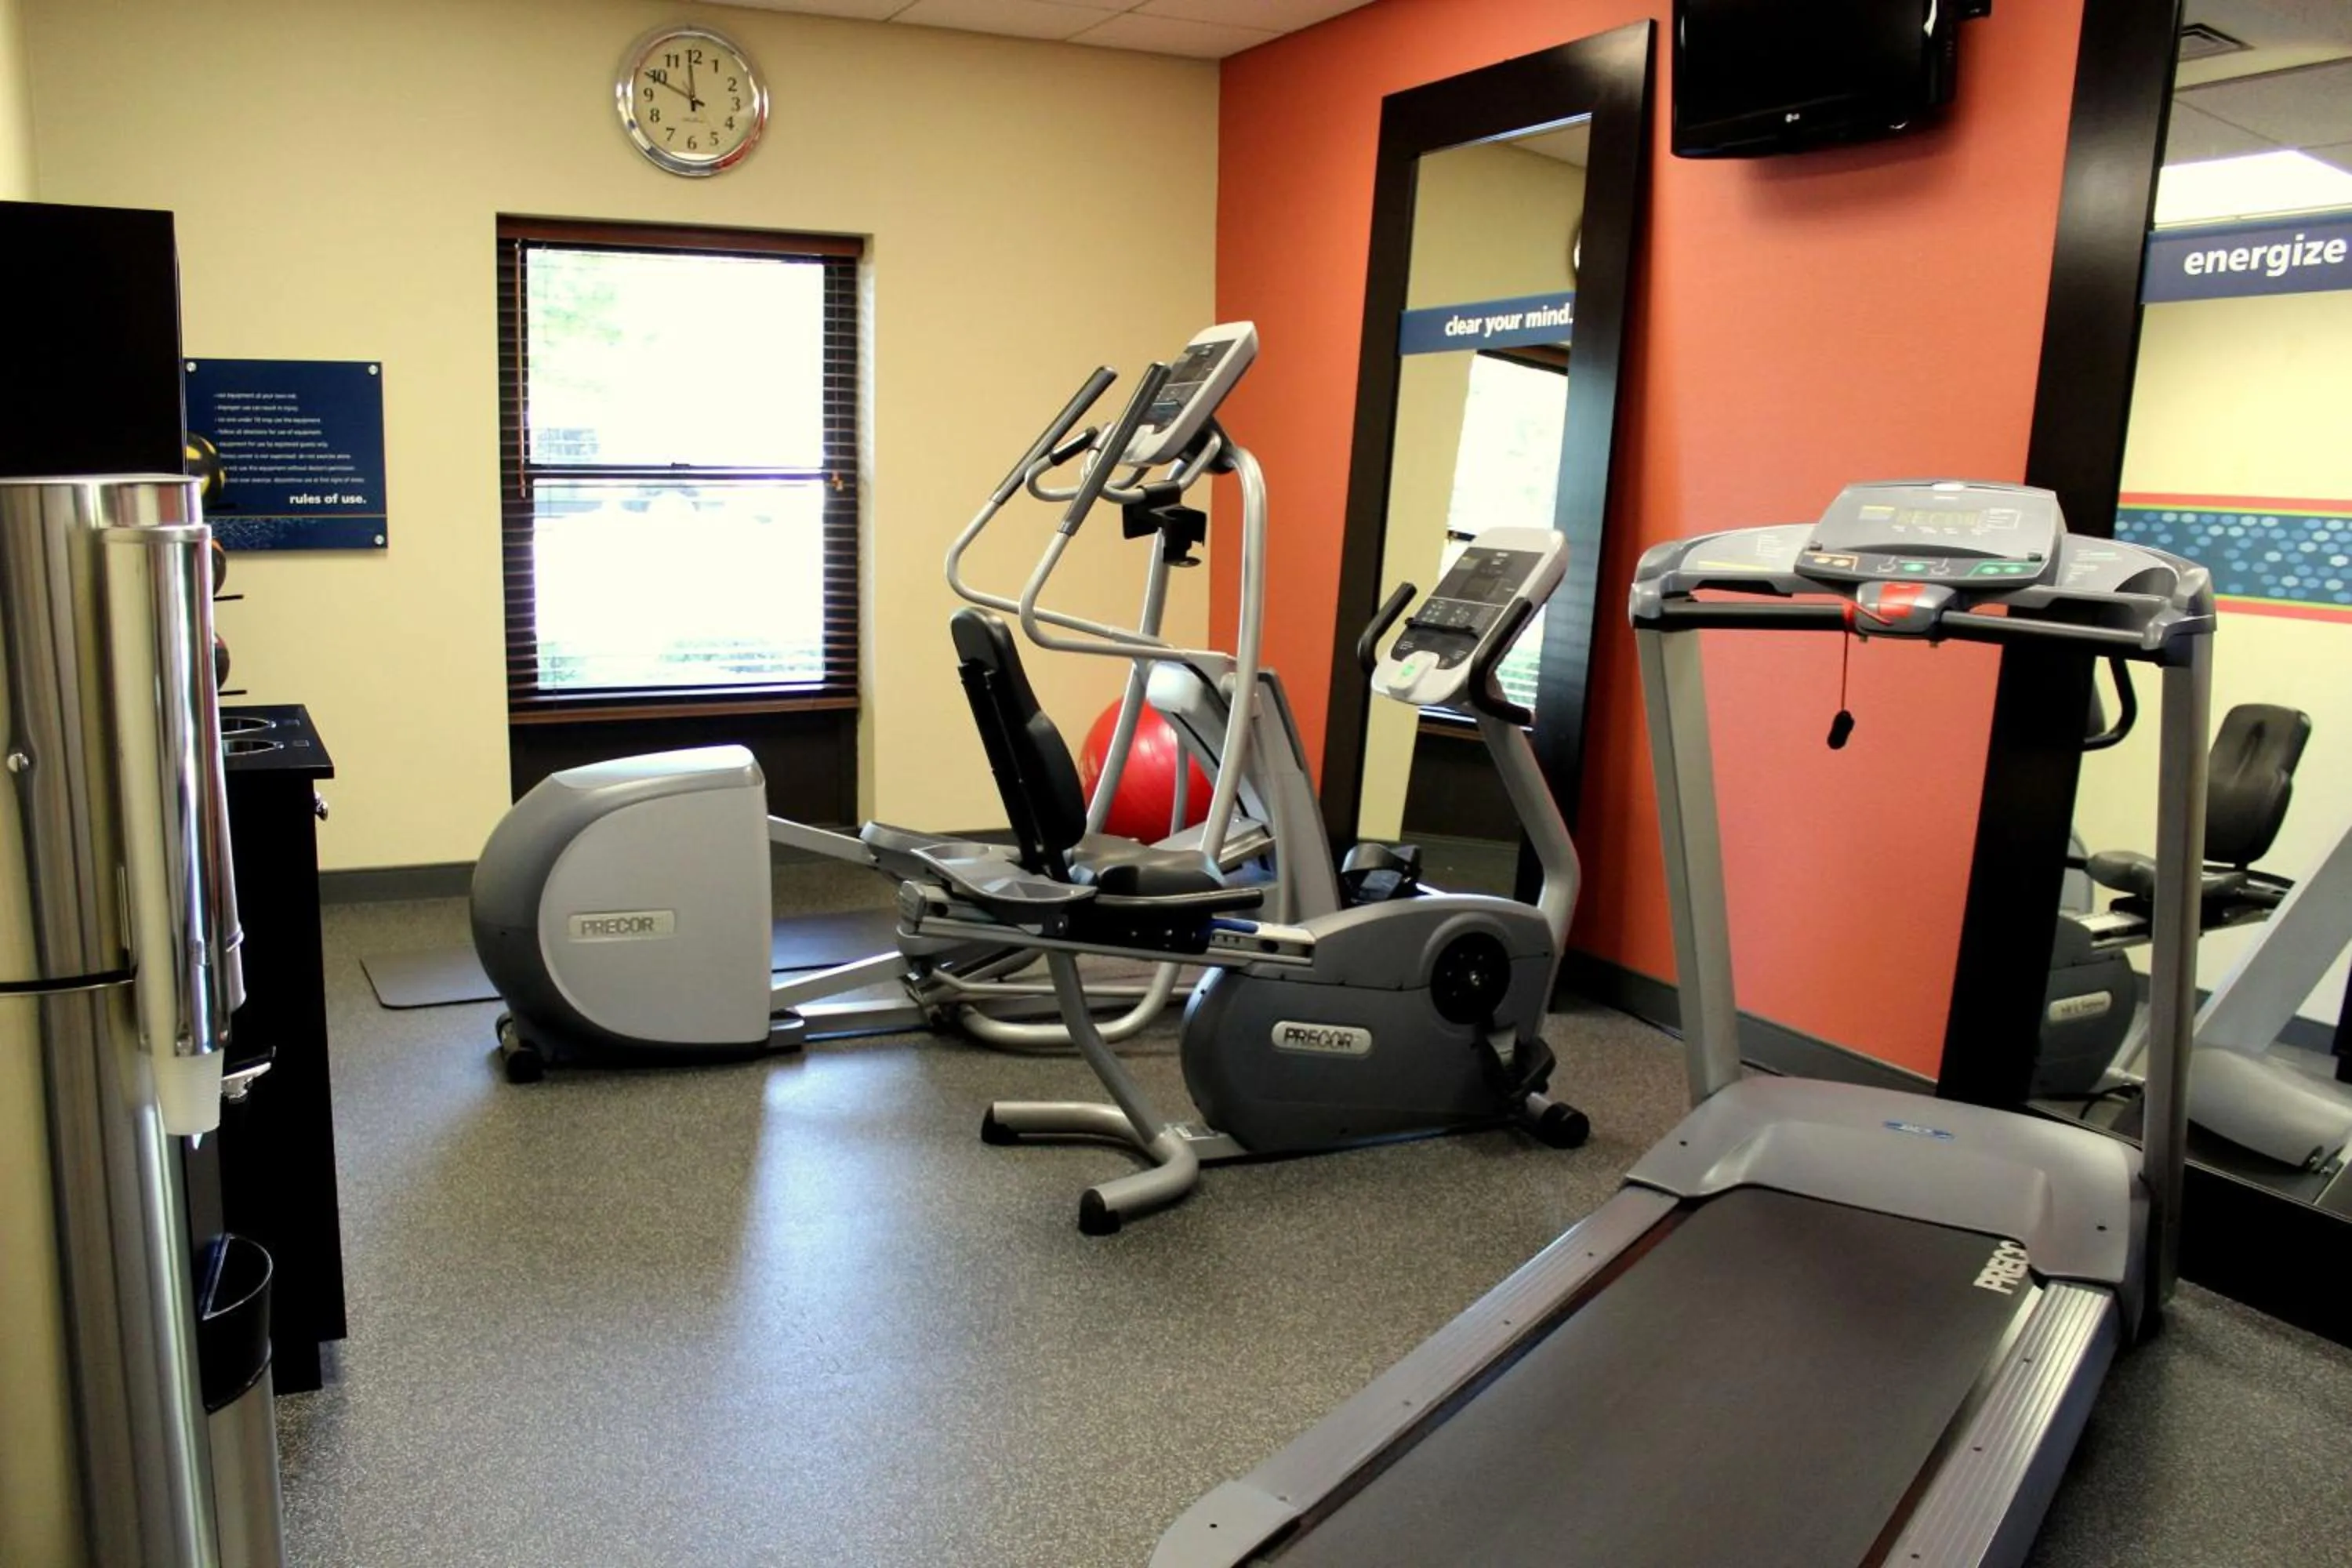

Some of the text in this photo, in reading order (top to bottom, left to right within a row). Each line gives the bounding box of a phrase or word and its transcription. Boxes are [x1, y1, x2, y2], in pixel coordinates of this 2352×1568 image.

[665, 53, 680, 68] 11
[685, 49, 702, 64] 12
[711, 59, 719, 74] 1
[649, 69, 667, 84] 10
[728, 78, 738, 92] 2
[643, 88, 654, 102] 9
[731, 97, 741, 111] 3
[649, 108, 660, 123] 8
[725, 116, 735, 130] 4
[666, 127, 676, 141] 7
[710, 132, 719, 146] 5
[687, 136, 697, 150] 6
[2183, 234, 2347, 277] energize
[1445, 302, 1574, 338] clear your mind.
[289, 492, 368, 505] rules of use.
[580, 916, 655, 935] PRECOR
[1283, 1027, 1354, 1050] PRECOR
